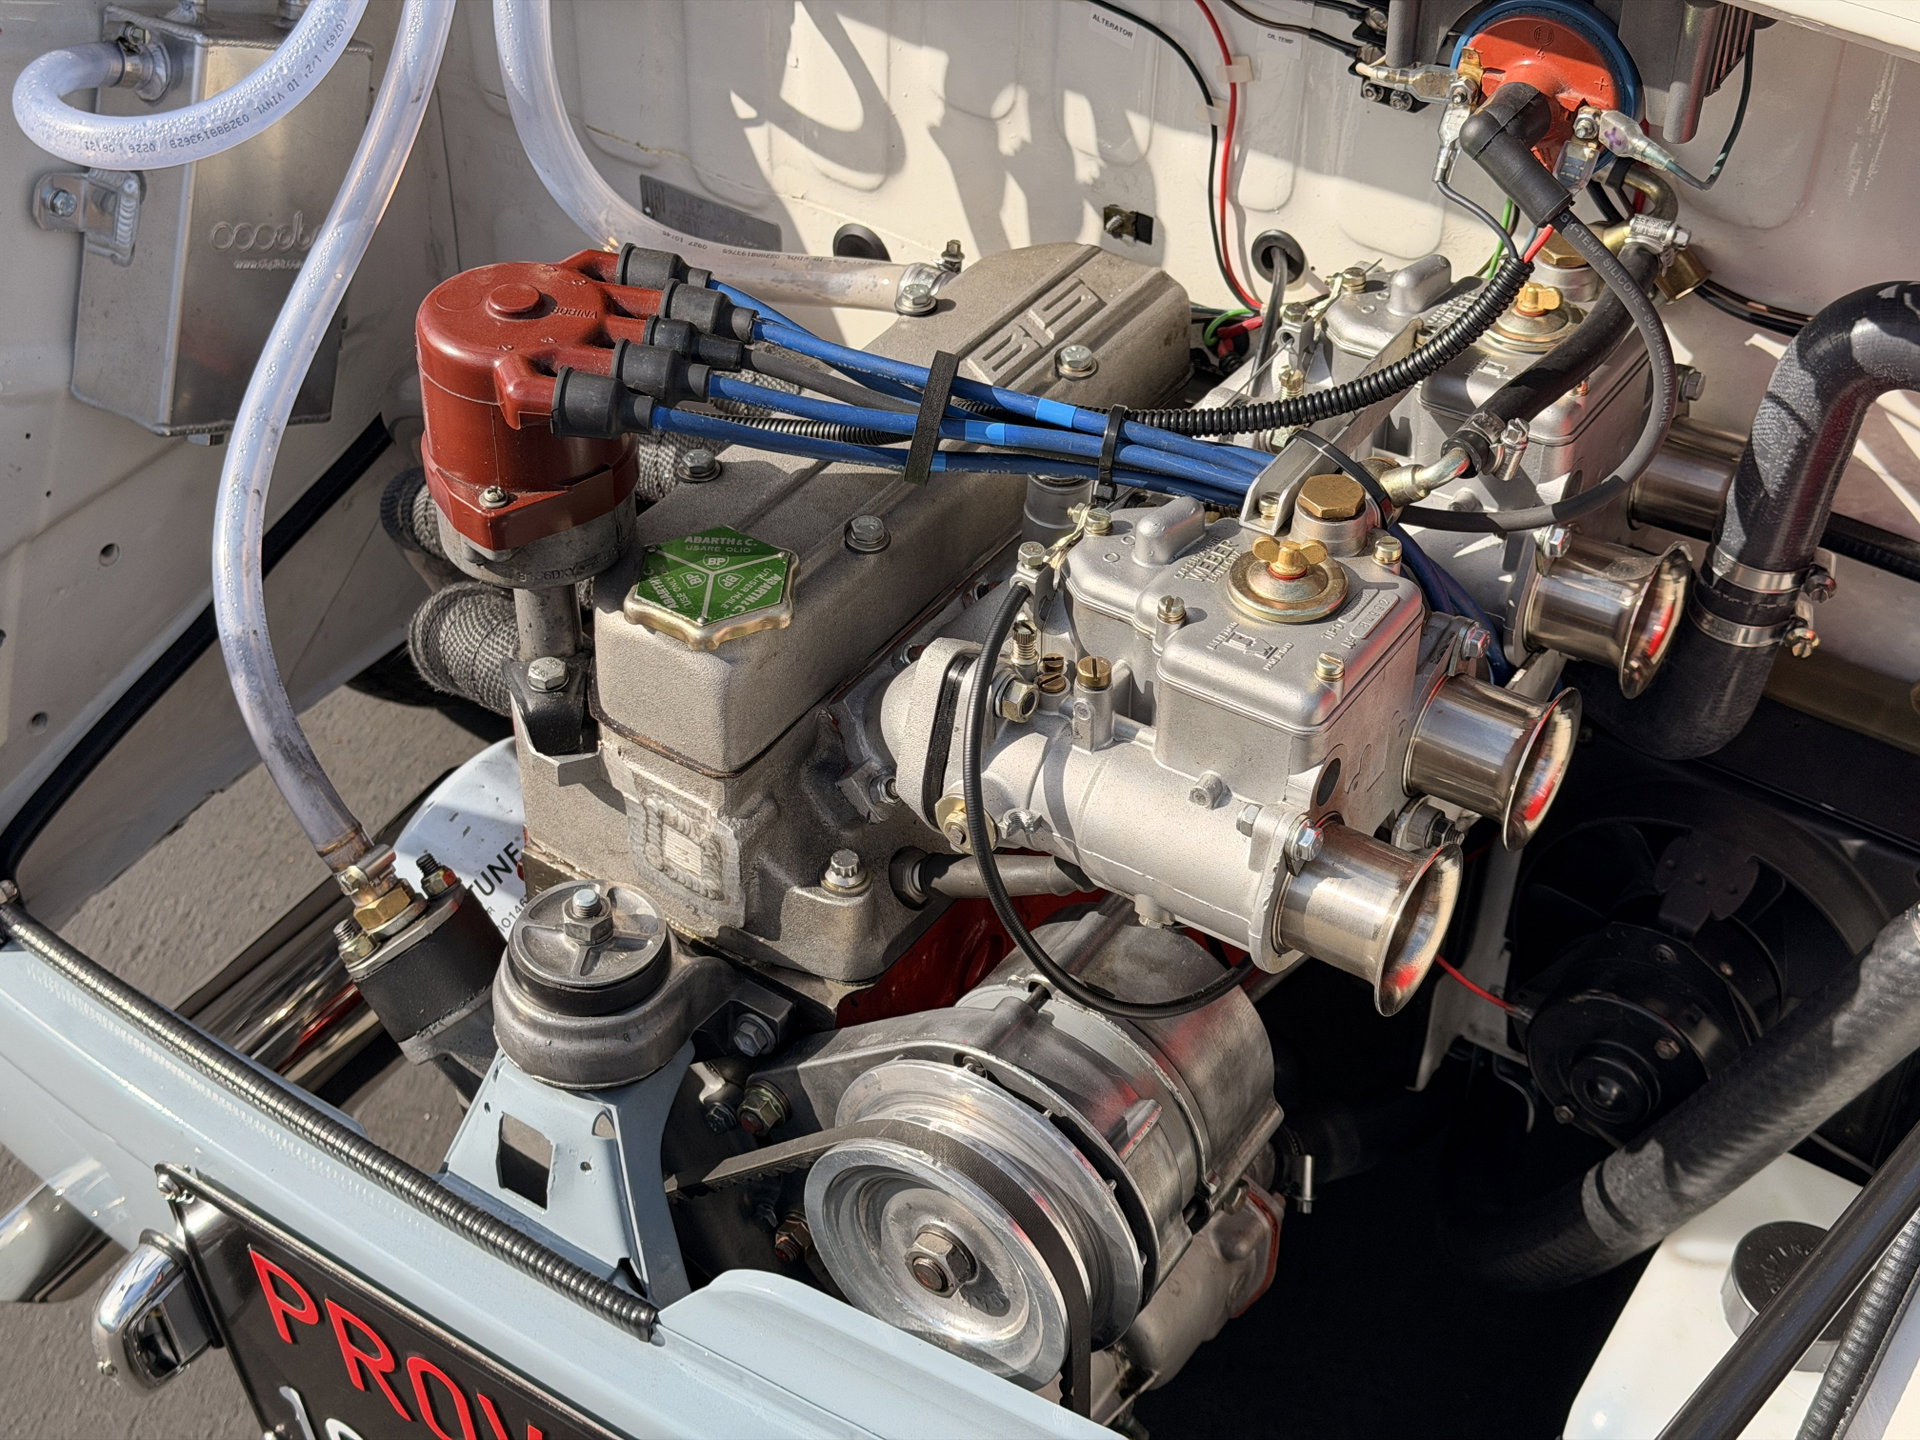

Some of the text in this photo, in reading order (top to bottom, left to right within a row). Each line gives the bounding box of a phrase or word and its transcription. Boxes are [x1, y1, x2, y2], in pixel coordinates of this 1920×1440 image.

[1092, 14, 1134, 39] ALTERATOR
[286, 78, 300, 93] ID
[254, 91, 285, 115] VINYL
[1604, 258, 1642, 306] SILICONE
[1644, 314, 1675, 395] SUPPRESSION
[684, 535, 737, 546] ABARTH
[707, 557, 727, 566] BP
[1186, 538, 1240, 583] WEBER
[666, 577, 681, 593] ONLY
[686, 572, 702, 586] BP
[724, 575, 739, 588] BP
[680, 592, 694, 609] USE
